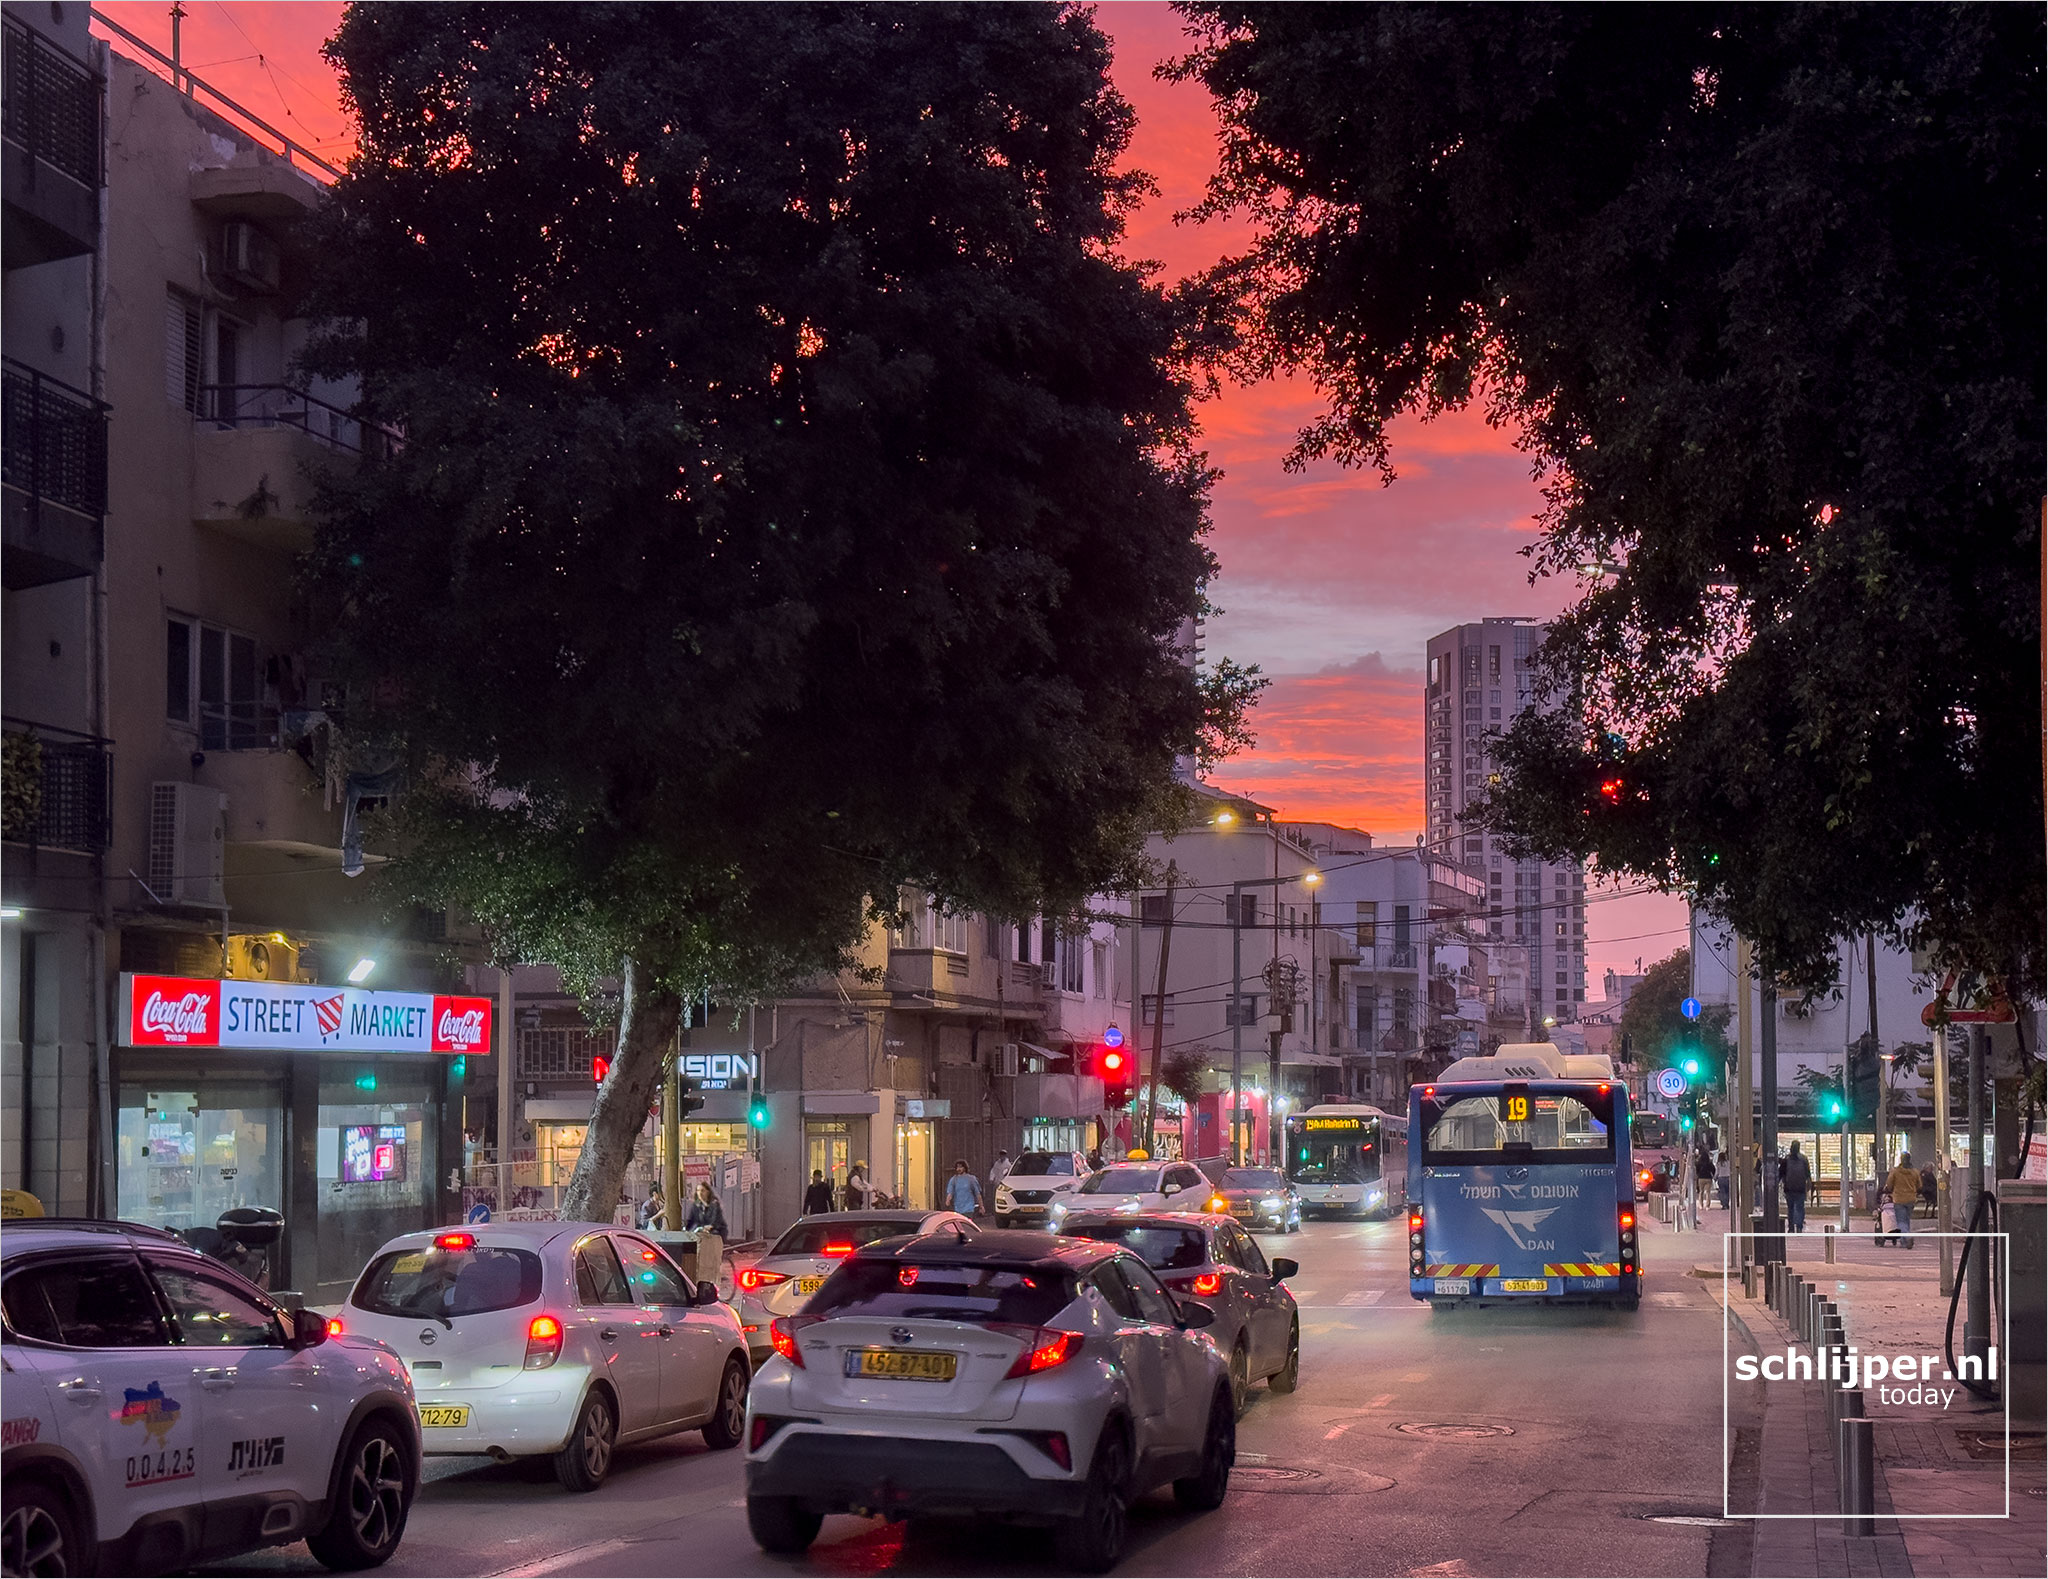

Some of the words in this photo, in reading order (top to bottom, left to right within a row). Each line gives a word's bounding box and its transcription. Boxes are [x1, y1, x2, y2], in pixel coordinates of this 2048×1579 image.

[142, 991, 211, 1033] Coca-Cola
[228, 996, 305, 1033] STREET
[350, 1003, 427, 1039] MARKET
[438, 1009, 484, 1043] Coca-Cola
[1664, 1077, 1681, 1089] 30
[1506, 1096, 1528, 1121] 19
[220, 1167, 238, 1175] כניסה
[1460, 1182, 1501, 1199] חשמלי
[1531, 1184, 1580, 1199] אוטובוס
[1527, 1240, 1555, 1251] DAN
